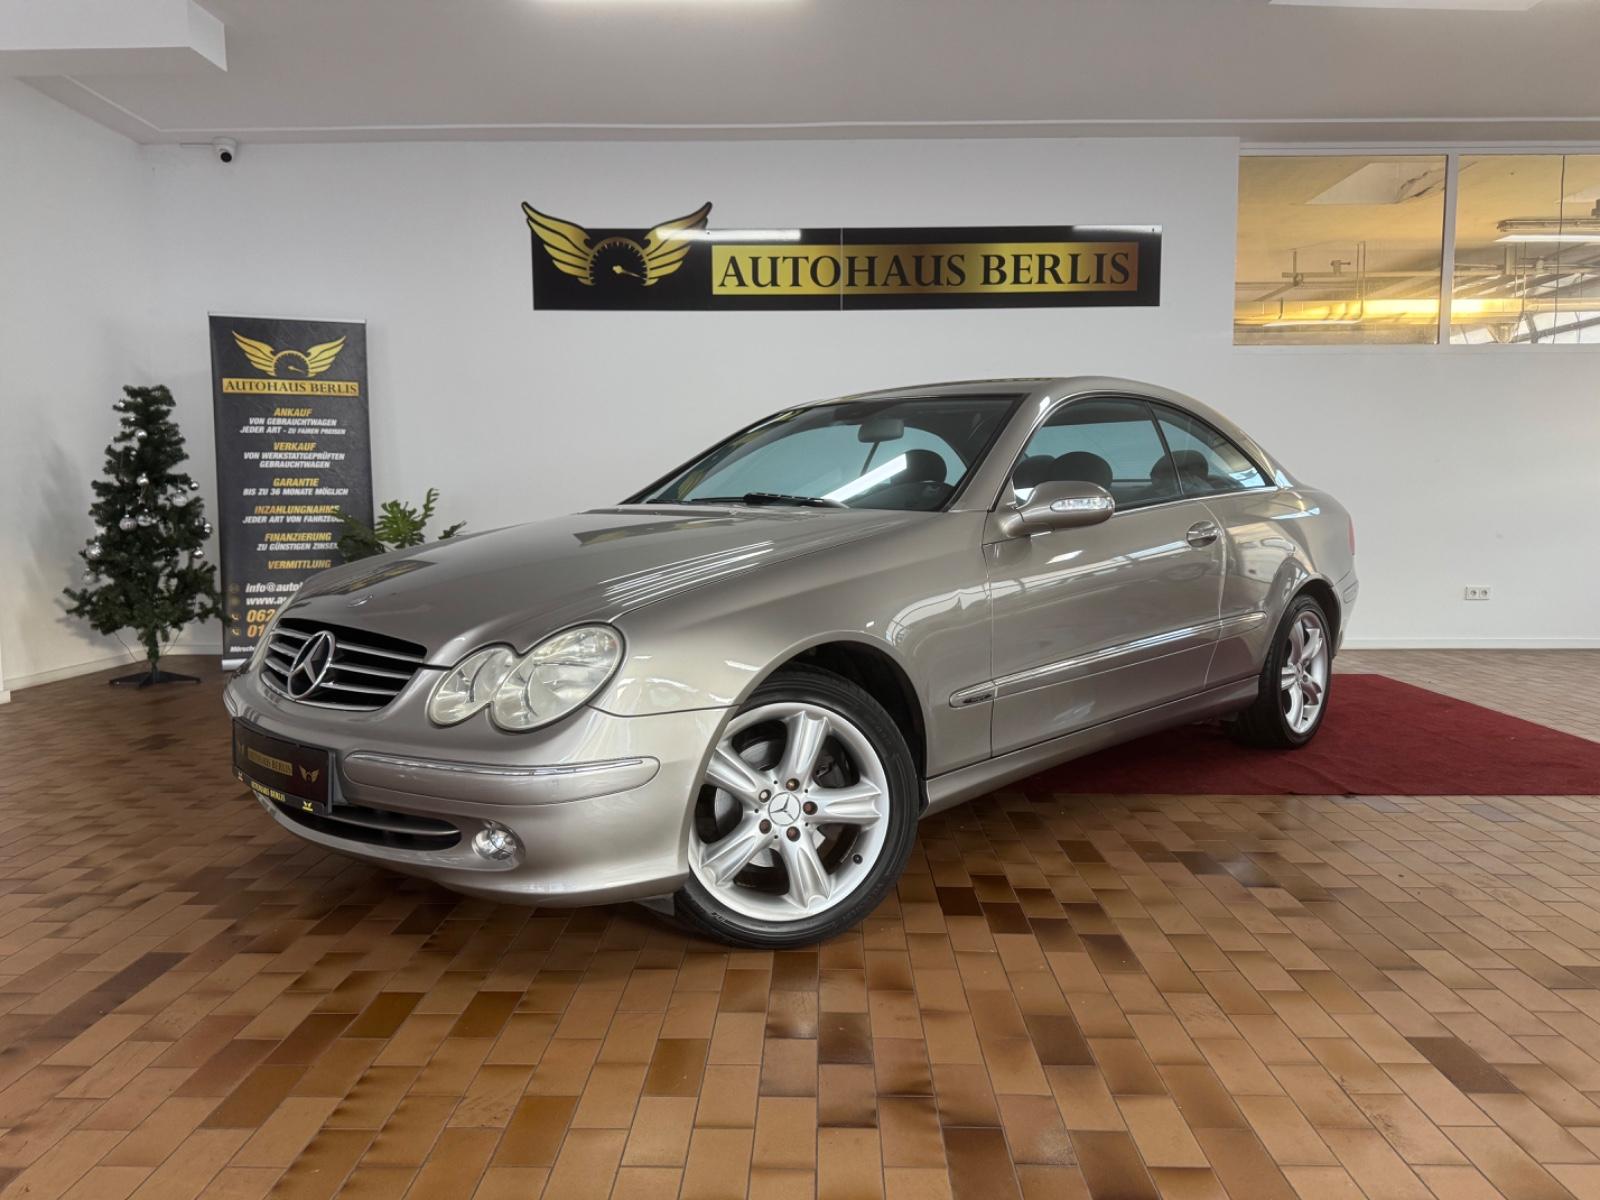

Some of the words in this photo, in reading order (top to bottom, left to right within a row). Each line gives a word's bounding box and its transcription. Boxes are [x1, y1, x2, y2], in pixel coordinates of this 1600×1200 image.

[718, 254, 967, 288] AUTOHAUS
[980, 251, 1131, 286] BERLIS
[225, 379, 306, 392] AUTOHAUS
[310, 382, 357, 394] BERLIS
[274, 408, 313, 416] ANKAUF
[240, 426, 265, 434] JEDER
[274, 443, 316, 451] VERKAUF
[244, 452, 260, 460] VON
[262, 452, 345, 461] WERKSTATTGEPRÜFTEN
[273, 478, 319, 487] GARANTIE
[243, 488, 256, 496] BIS
[258, 488, 269, 496] ZU
[270, 488, 280, 496] 36
[282, 488, 313, 496] MONATE
[315, 487, 349, 496] MÖGLICH
[242, 516, 268, 524] JEDER
[265, 532, 332, 542] FINANZIERUNG
[257, 544, 268, 552] ZU
[269, 543, 311, 551] GÜNSTIGEN
[268, 560, 332, 569] VERMITTLUNG
[246, 609, 276, 623] 062
[247, 625, 266, 638] 01
